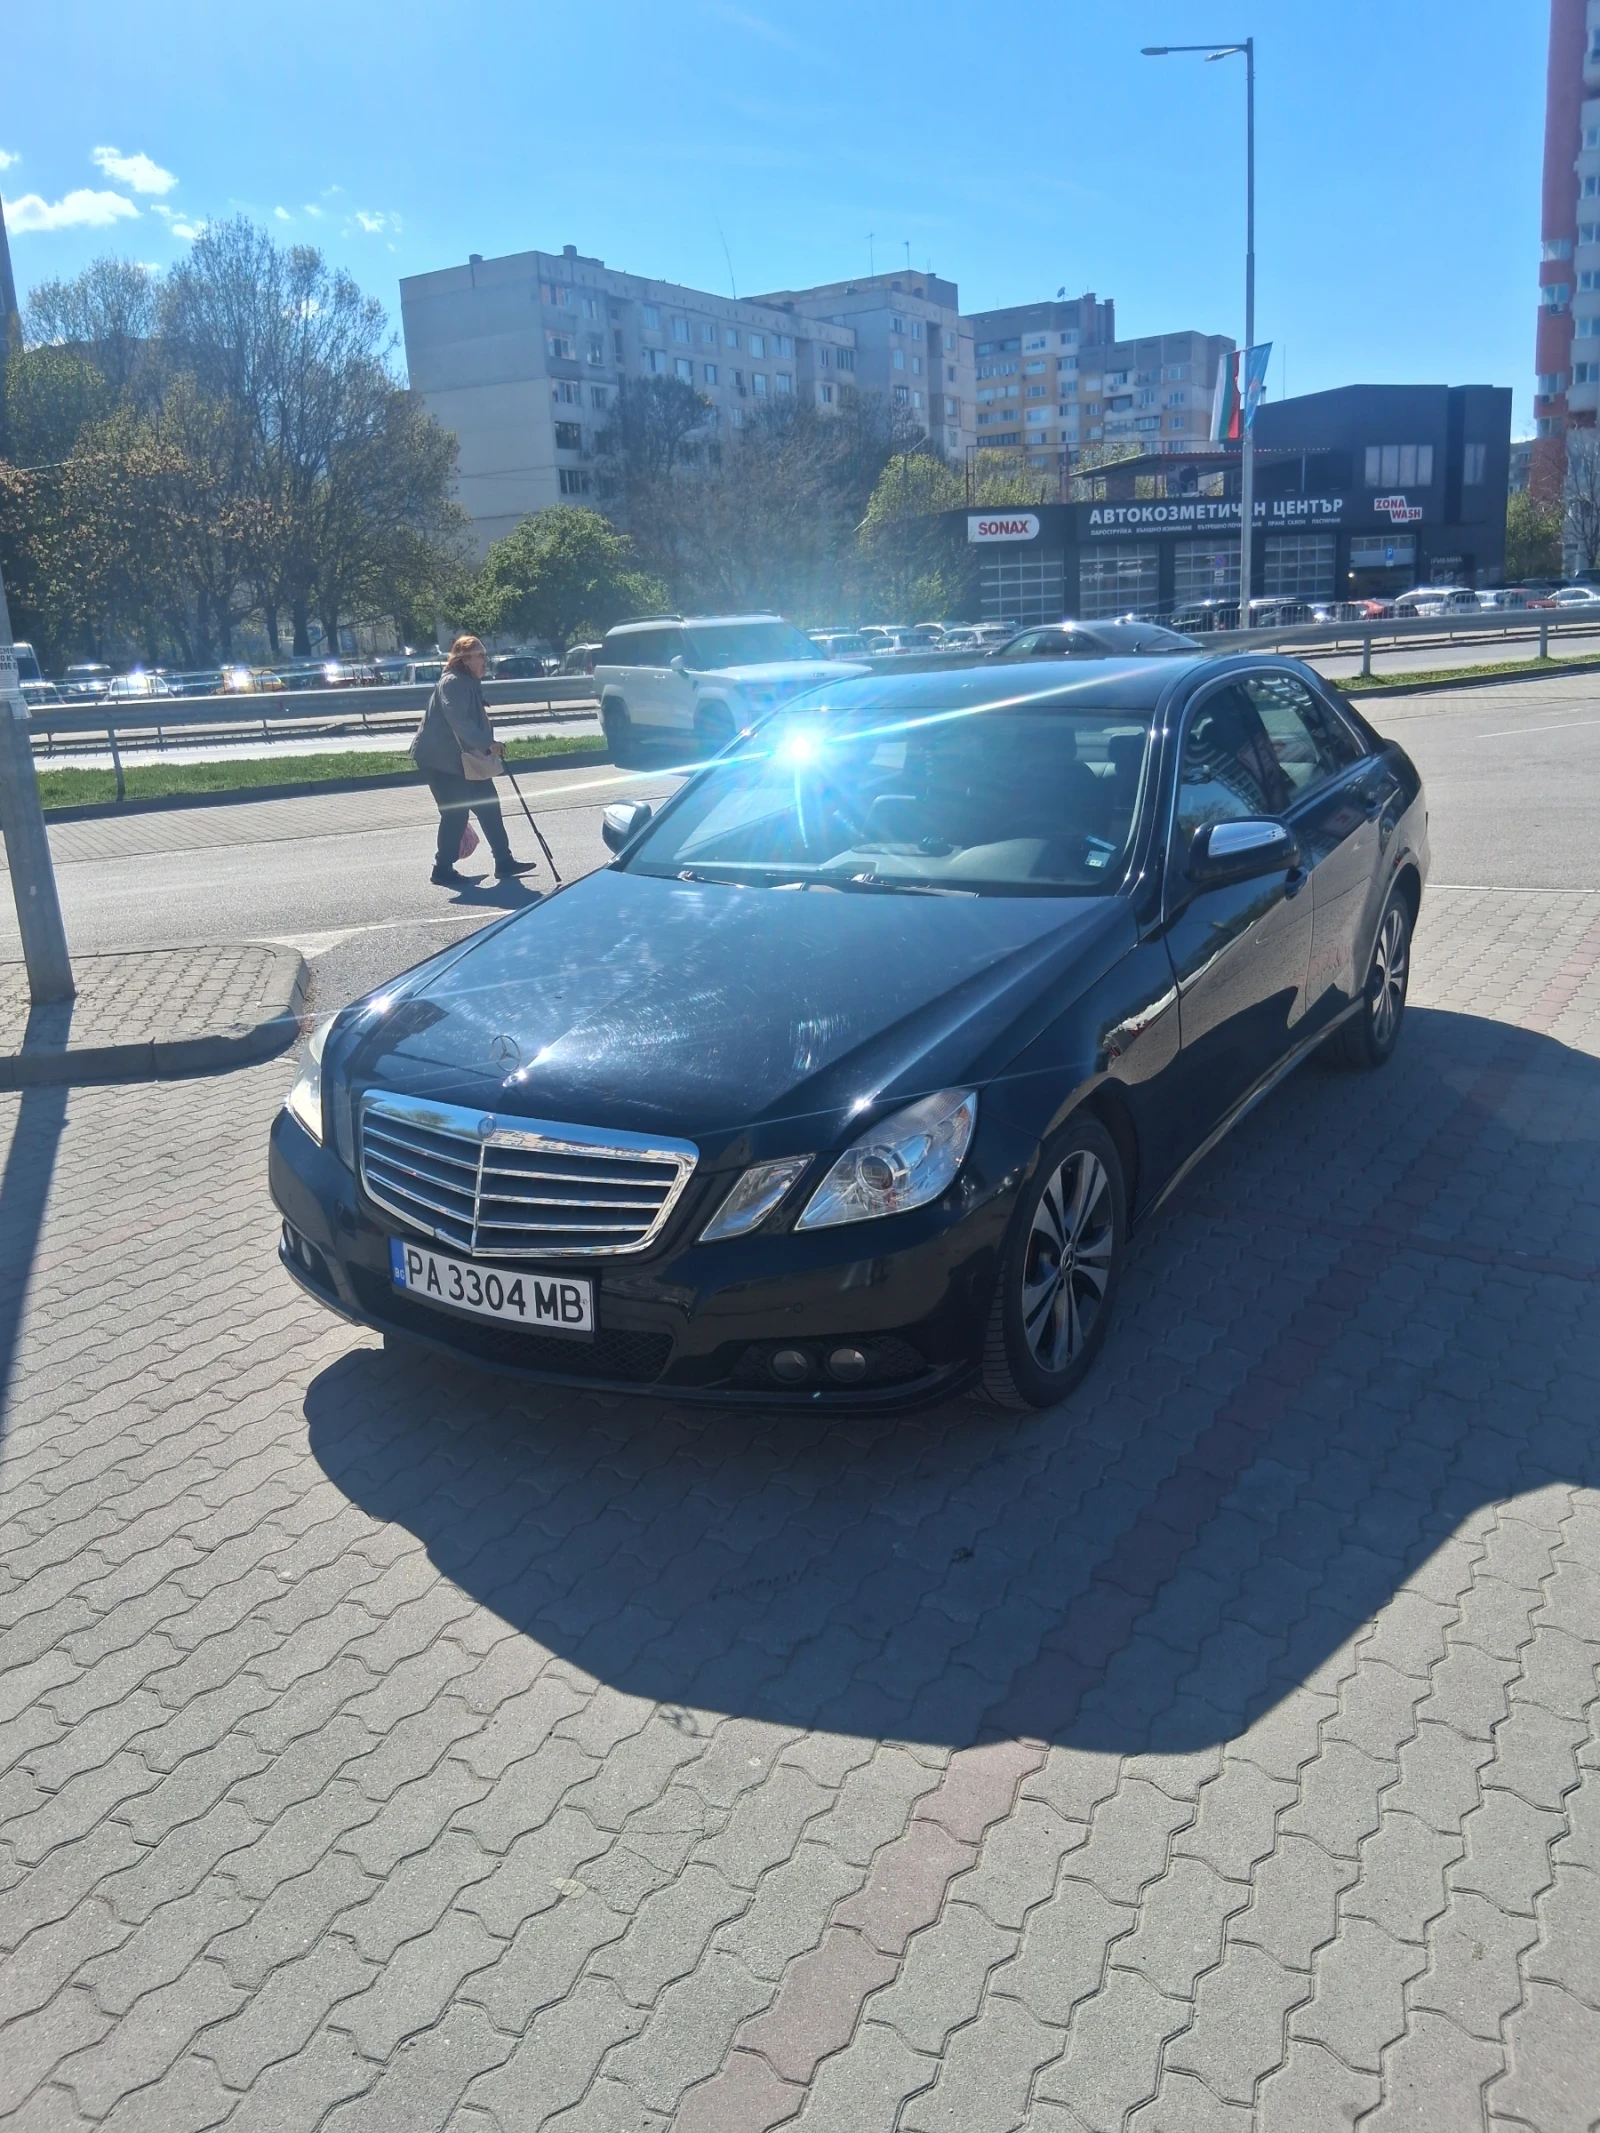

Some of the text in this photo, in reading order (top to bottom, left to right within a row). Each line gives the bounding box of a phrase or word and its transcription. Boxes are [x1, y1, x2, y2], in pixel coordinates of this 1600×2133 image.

[1089, 499, 1343, 524] АВТОКОЗМЕТИЧН ЦЕНТЪР
[1375, 499, 1405, 509] ZONA
[1391, 508, 1421, 519] WASH
[978, 520, 1029, 536] SONAX
[394, 1266, 406, 1281] BG
[407, 1248, 584, 1324] PA 3304 MB
